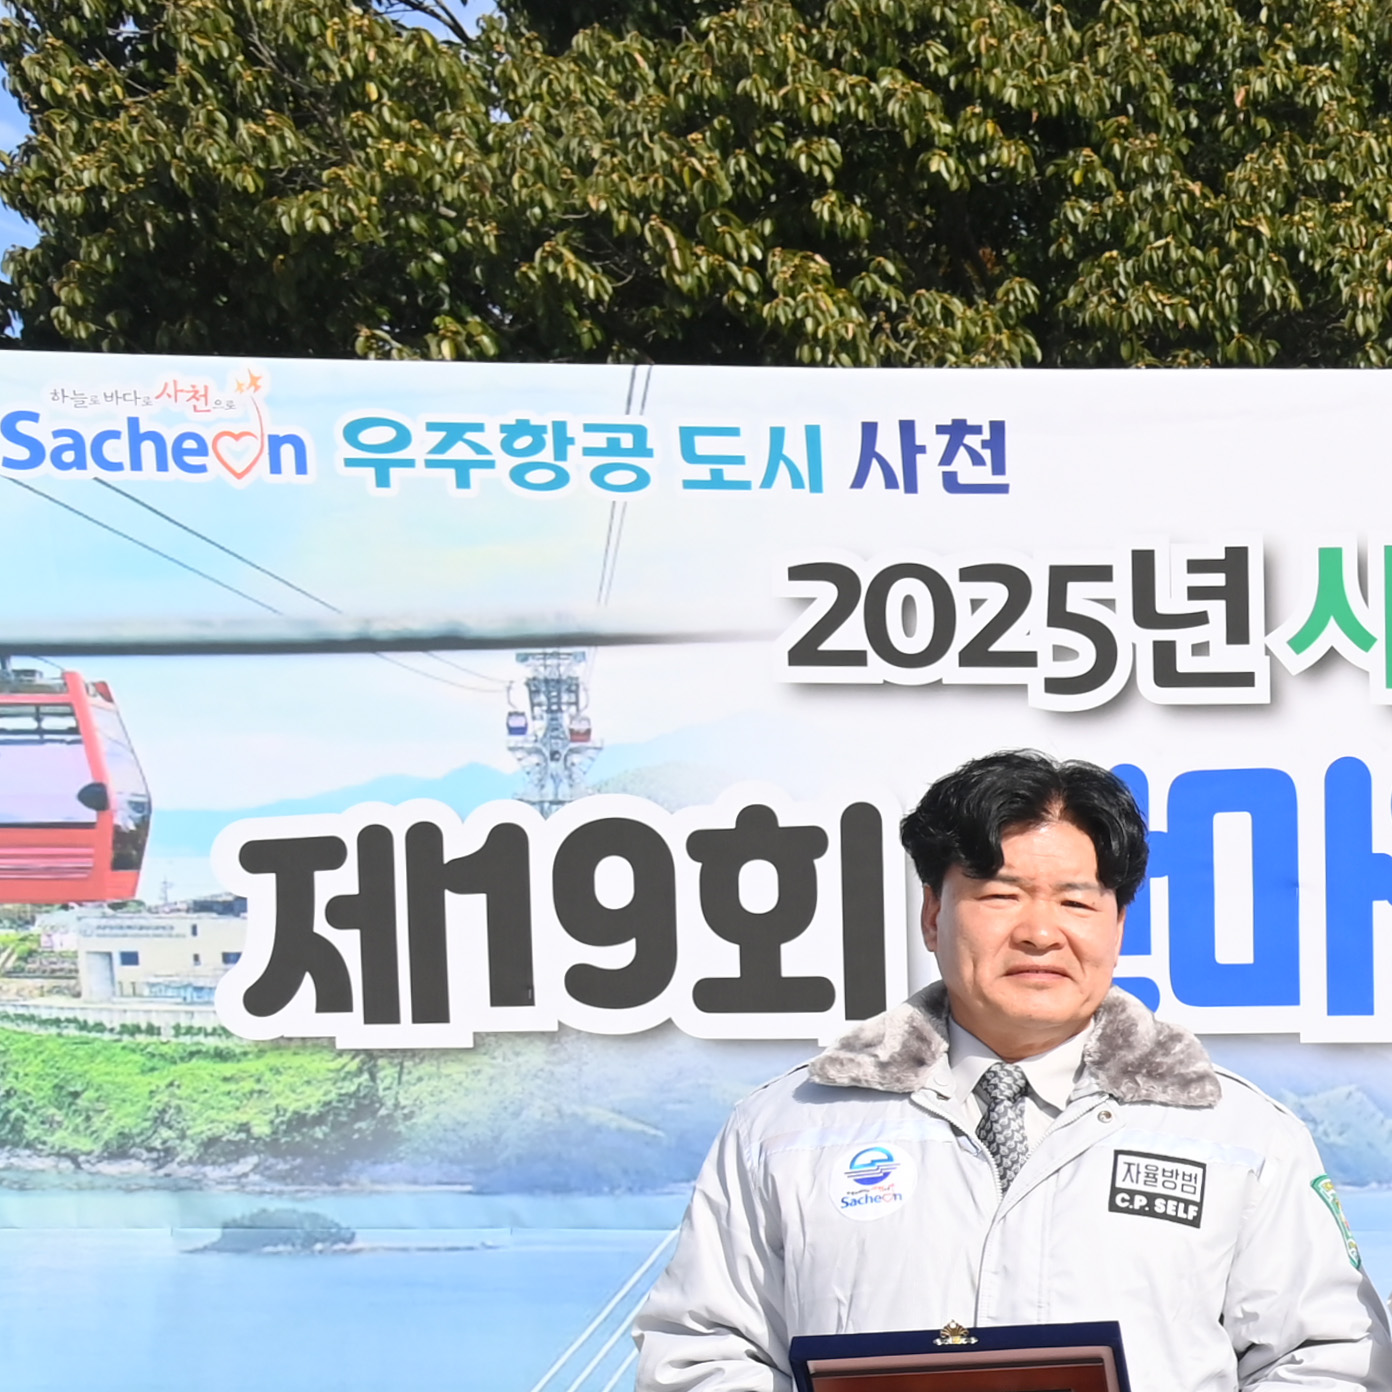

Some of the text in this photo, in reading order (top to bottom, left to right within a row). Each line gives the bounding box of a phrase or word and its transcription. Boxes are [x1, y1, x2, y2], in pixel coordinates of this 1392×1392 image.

[342, 417, 1010, 494] 우주항공 도시 사천
[788, 546, 1255, 695] 2025년
[240, 802, 886, 1026] 제19회
[1115, 1192, 1199, 1221] C.P. SELF
[1122, 1161, 1198, 1195] 자율방범
